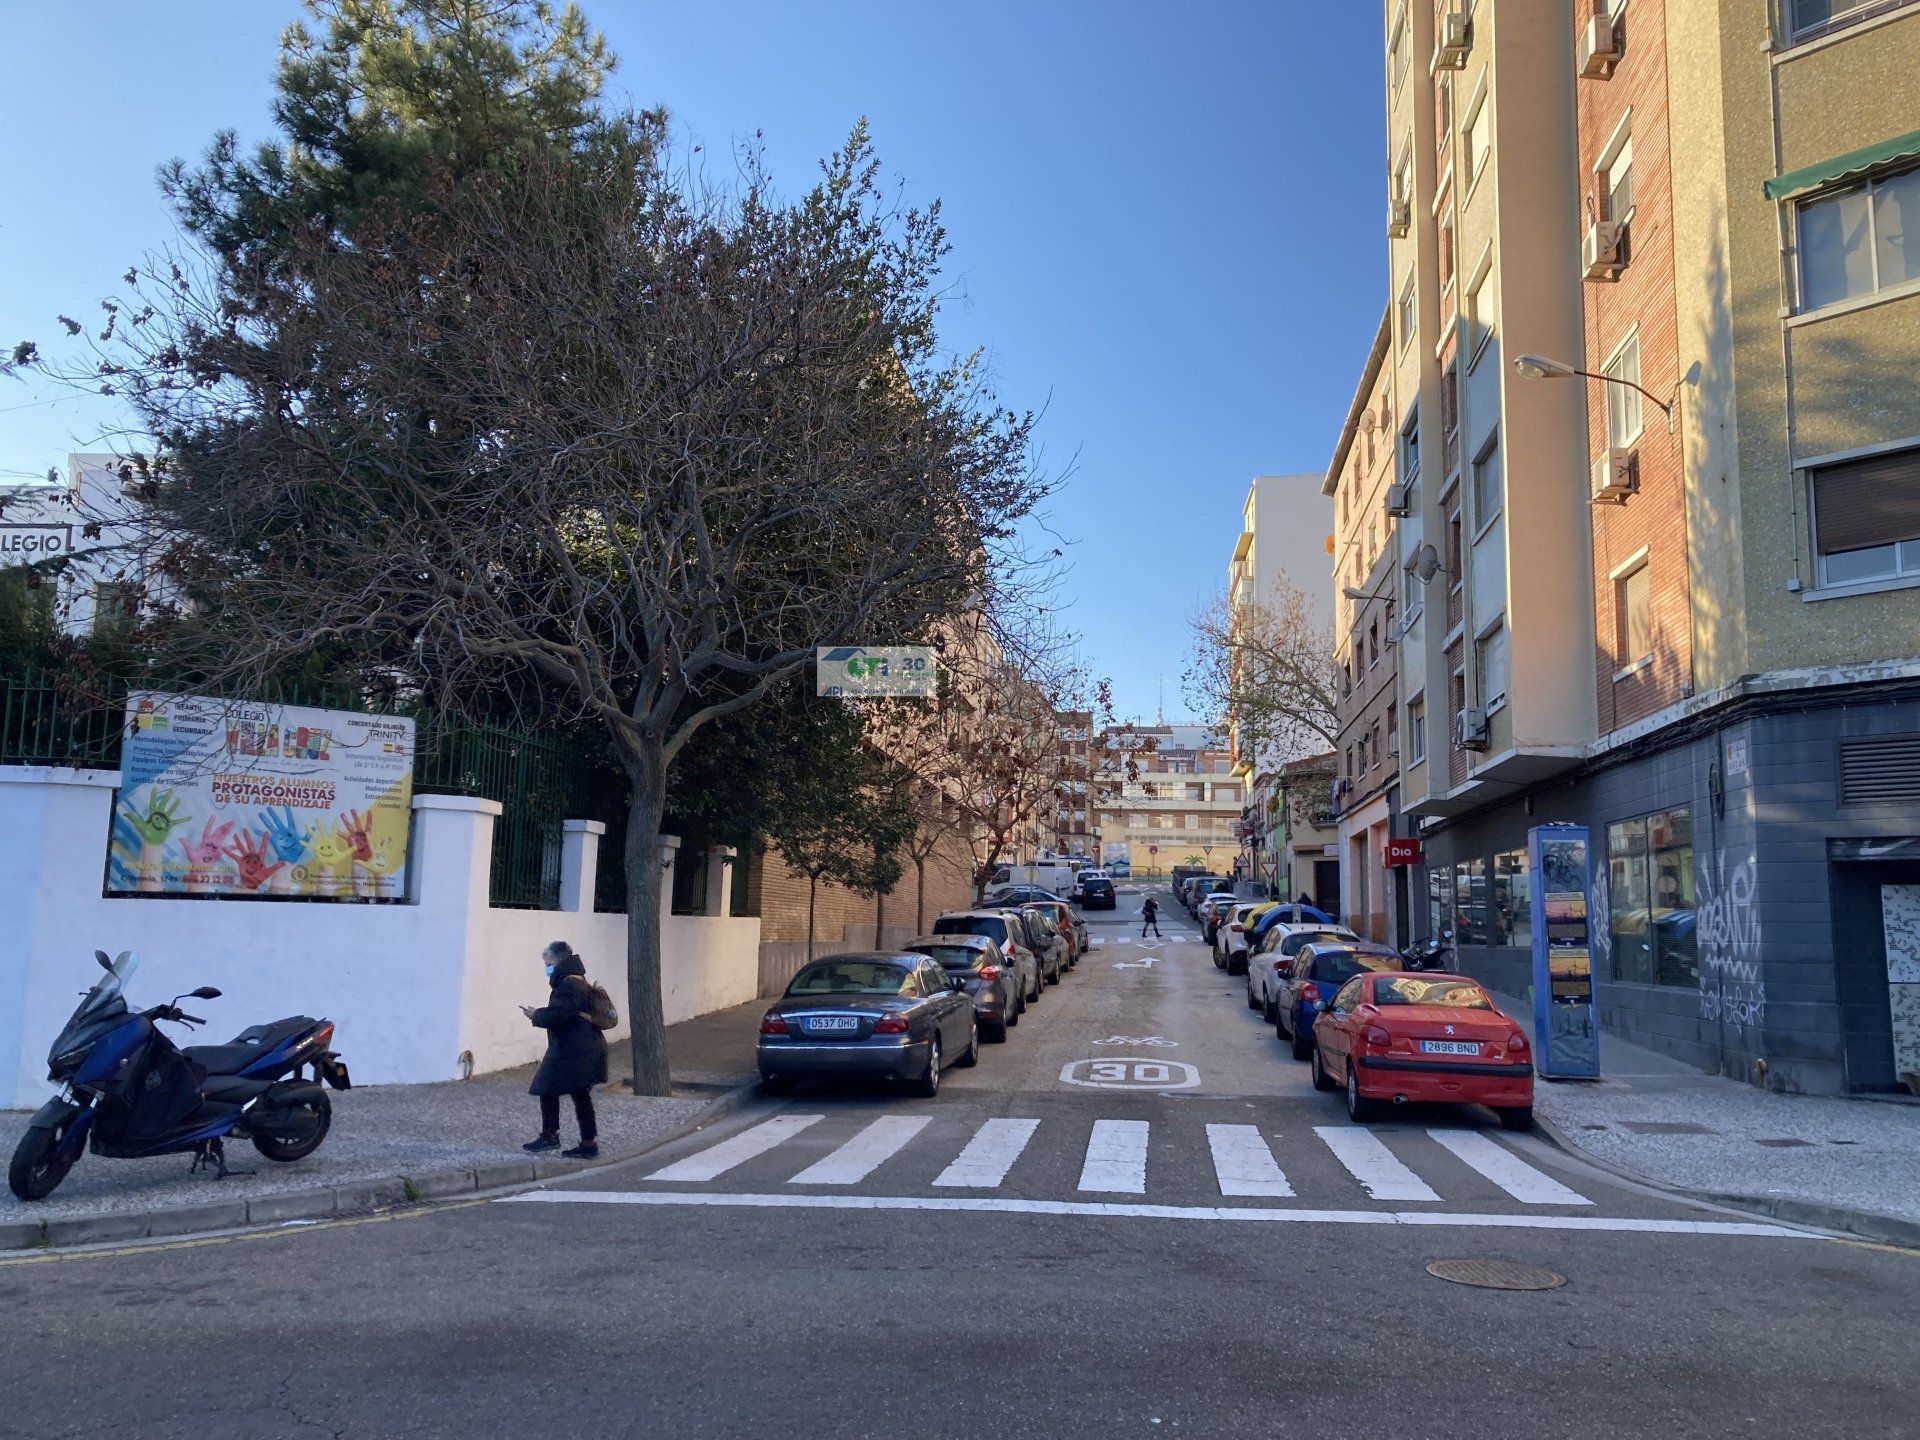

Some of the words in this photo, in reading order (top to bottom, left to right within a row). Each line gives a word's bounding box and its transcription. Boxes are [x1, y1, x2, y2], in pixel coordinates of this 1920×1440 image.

[173, 714, 206, 723] PRIMARIA
[226, 709, 265, 722] COLEGIO
[347, 719, 382, 729] CONCERTADO
[172, 726, 213, 736] SECUNDARIA
[369, 730, 406, 740] TRINITY
[213, 774, 276, 786] NUESTROS
[278, 777, 336, 790] ALUMNOS
[343, 775, 375, 784] Actividades
[211, 781, 336, 801] PROTAGONISTAS
[215, 793, 232, 804] DE
[234, 794, 250, 805] SU
[252, 796, 331, 810] APRENDIZAJE
[811, 1018, 835, 1028] 0537
[837, 1018, 856, 1028] DHG
[1427, 1042, 1454, 1052] 2896
[1457, 1044, 1477, 1054] BND
[1089, 1063, 1170, 1082] 30
